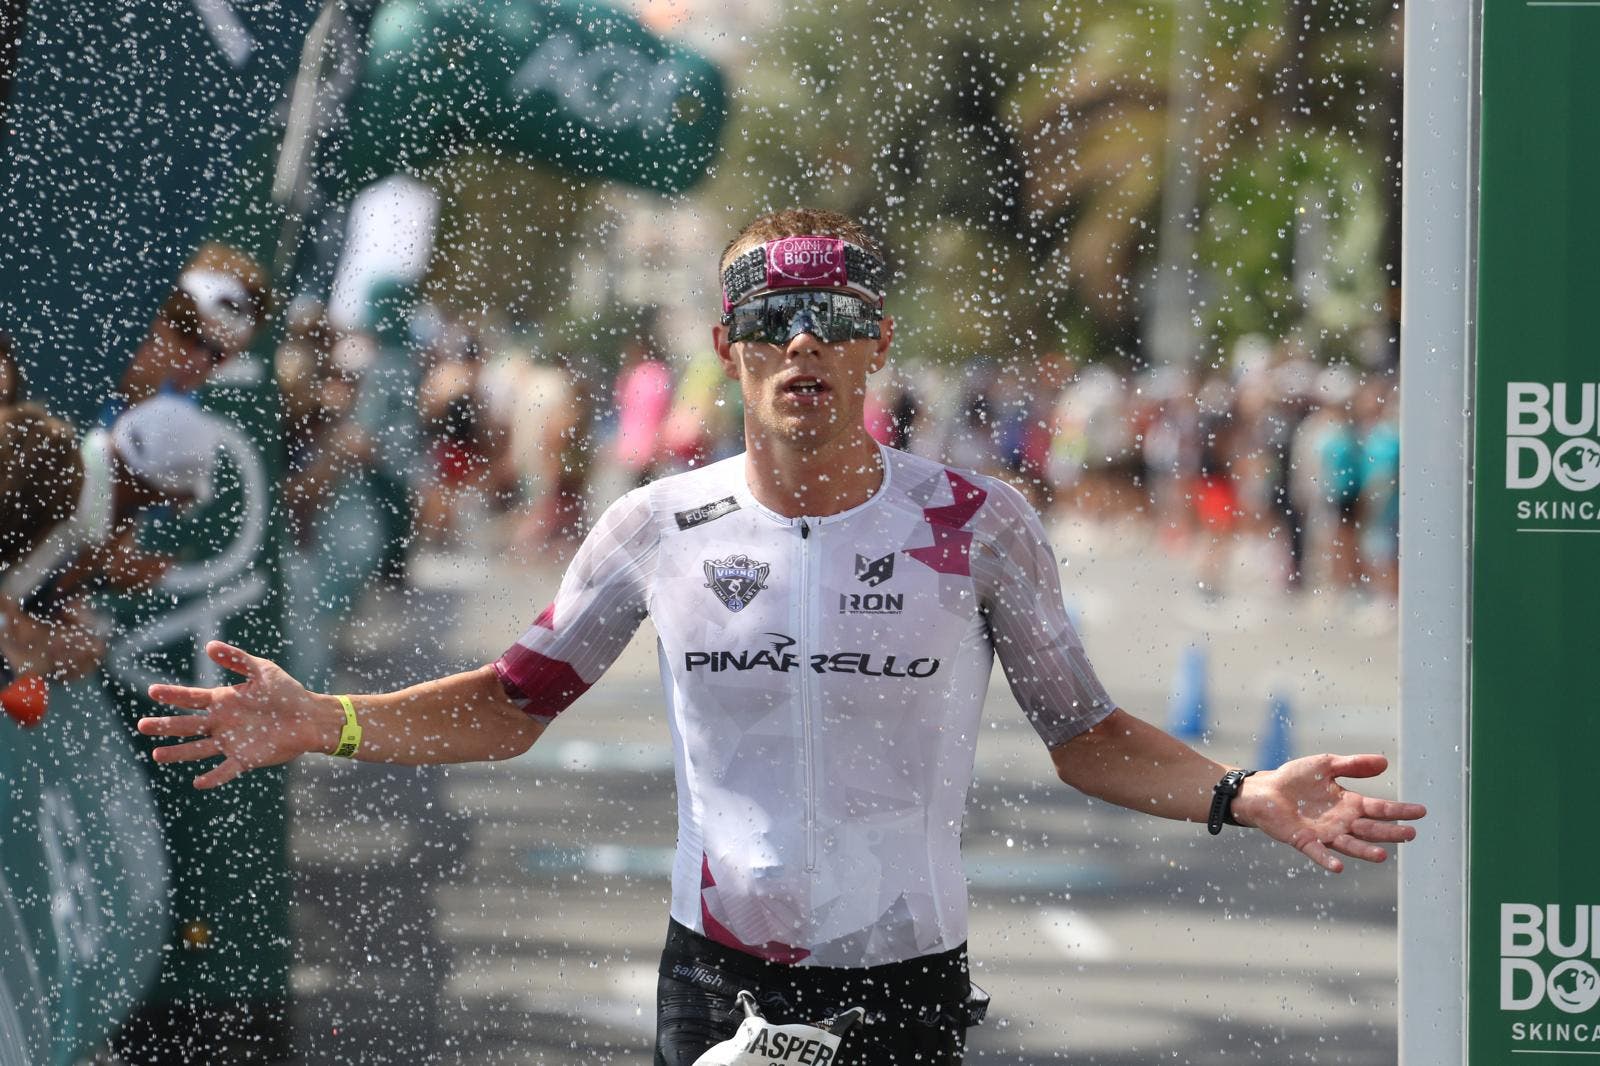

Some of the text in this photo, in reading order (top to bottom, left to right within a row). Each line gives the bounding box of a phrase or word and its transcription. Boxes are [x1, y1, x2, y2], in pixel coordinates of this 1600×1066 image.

[1506, 382, 1600, 436] BU
[1517, 501, 1600, 520] SKINC
[716, 569, 755, 578] VIKING
[840, 593, 904, 611] IRON
[1500, 903, 1600, 959] BU
[744, 1027, 834, 1066] ASPER
